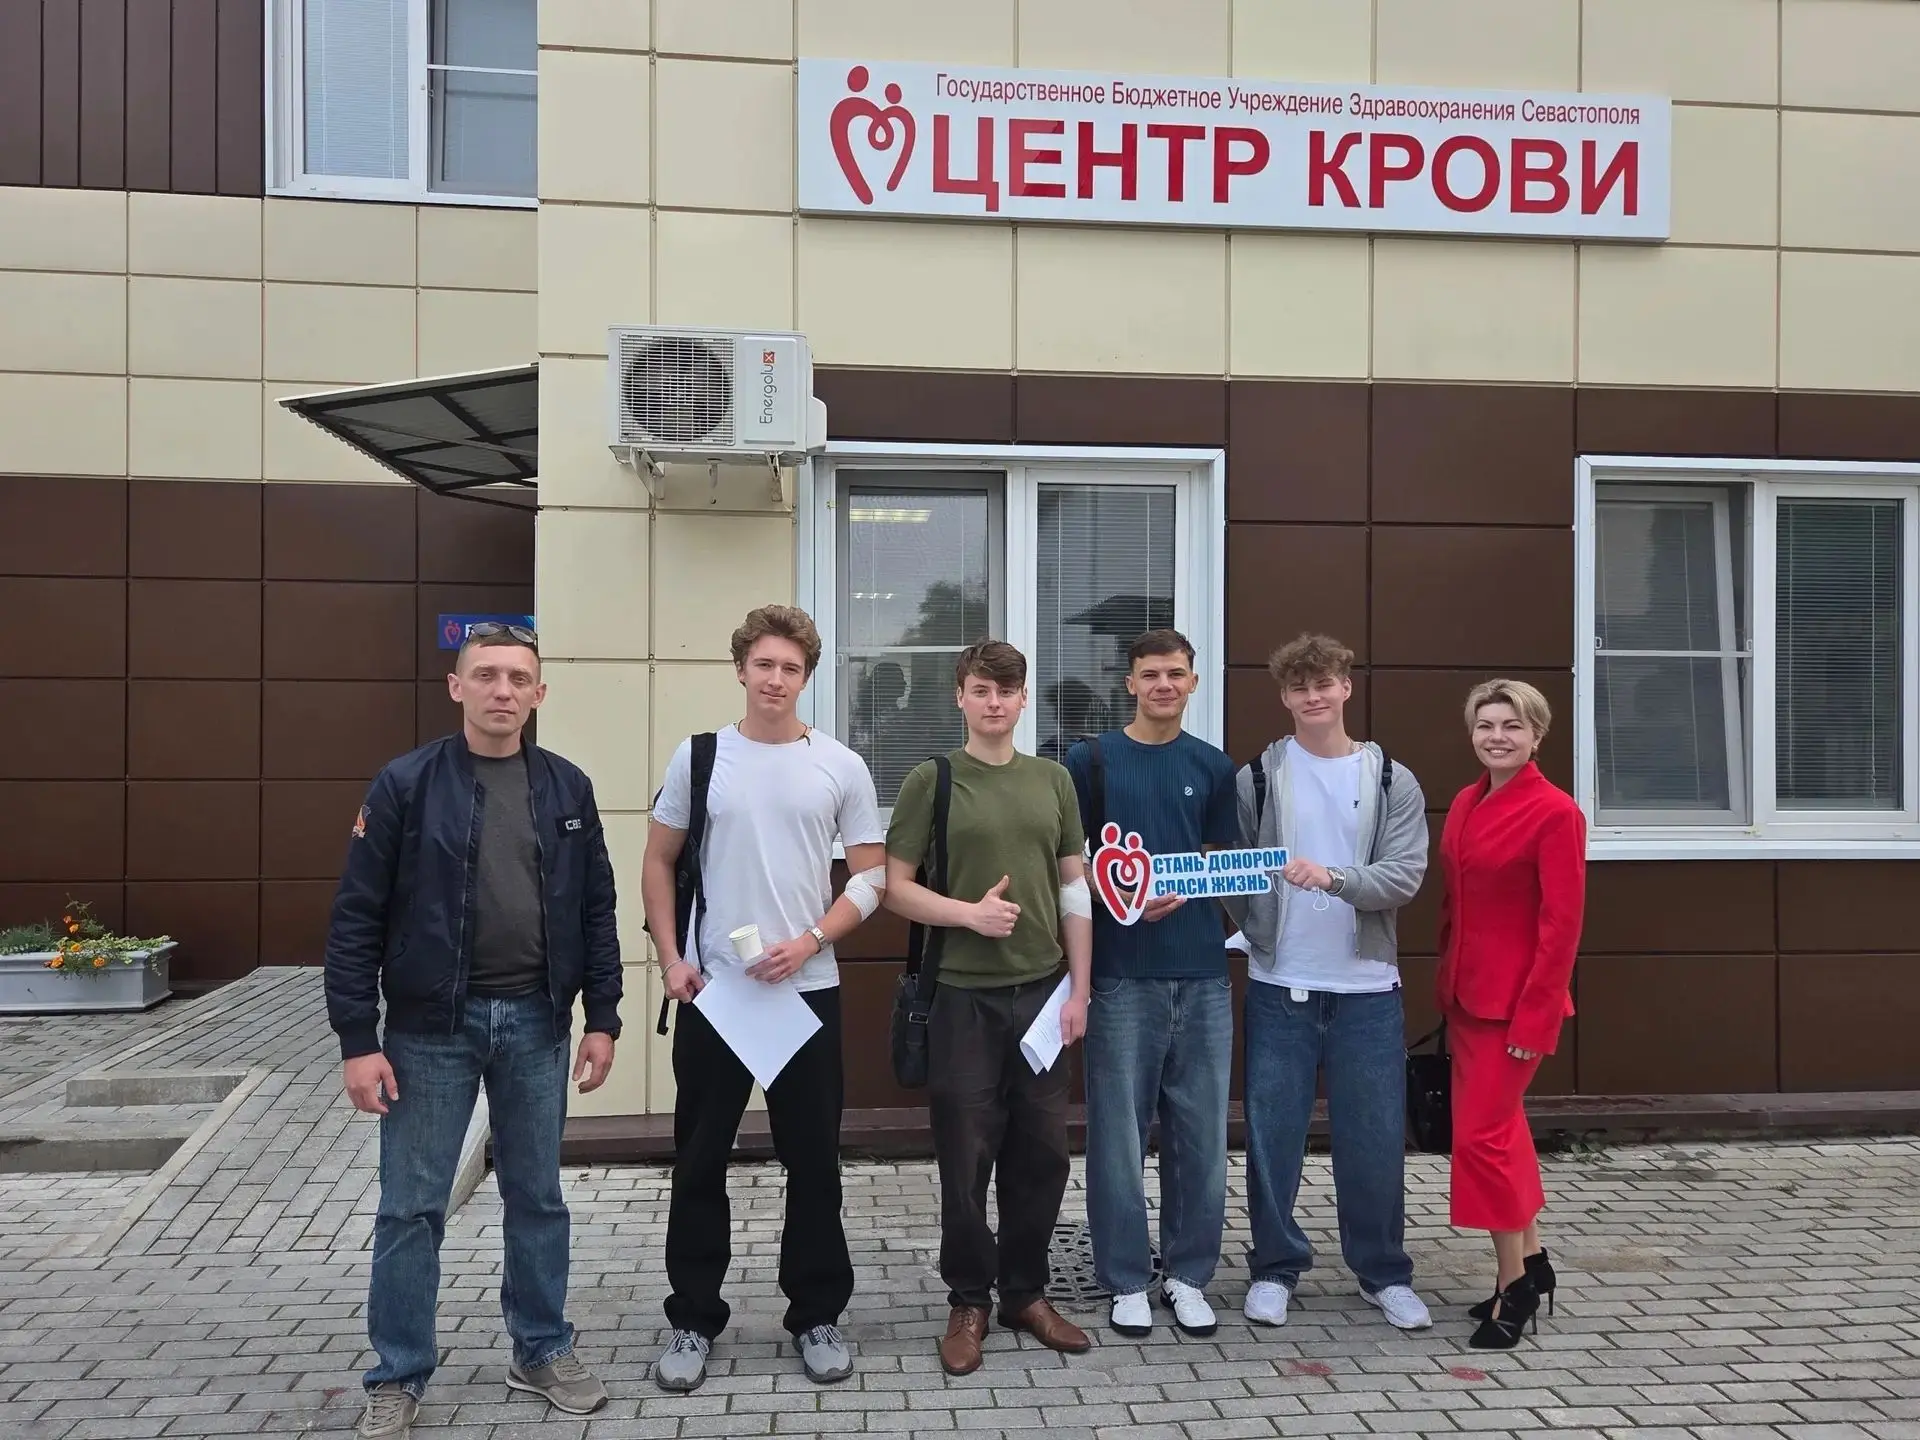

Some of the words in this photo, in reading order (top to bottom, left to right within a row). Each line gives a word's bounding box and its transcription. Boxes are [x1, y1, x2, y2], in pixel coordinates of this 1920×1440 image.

[936, 73, 1105, 104] Государственное
[1112, 82, 1221, 109] Бюджетное
[1228, 86, 1343, 115] Учреждение
[1350, 92, 1515, 124] Здравоохранения
[1521, 99, 1640, 125] Севастополя
[933, 114, 1270, 212] ЦЕНТР
[1308, 130, 1639, 216] КРОВИ
[760, 351, 777, 424] Energolux
[1153, 856, 1204, 874] СТАНЬ
[1208, 850, 1287, 873] ДОНОРОМ
[1155, 877, 1207, 896] СПАСИ
[1211, 874, 1268, 893] ЖИЗНЬ
